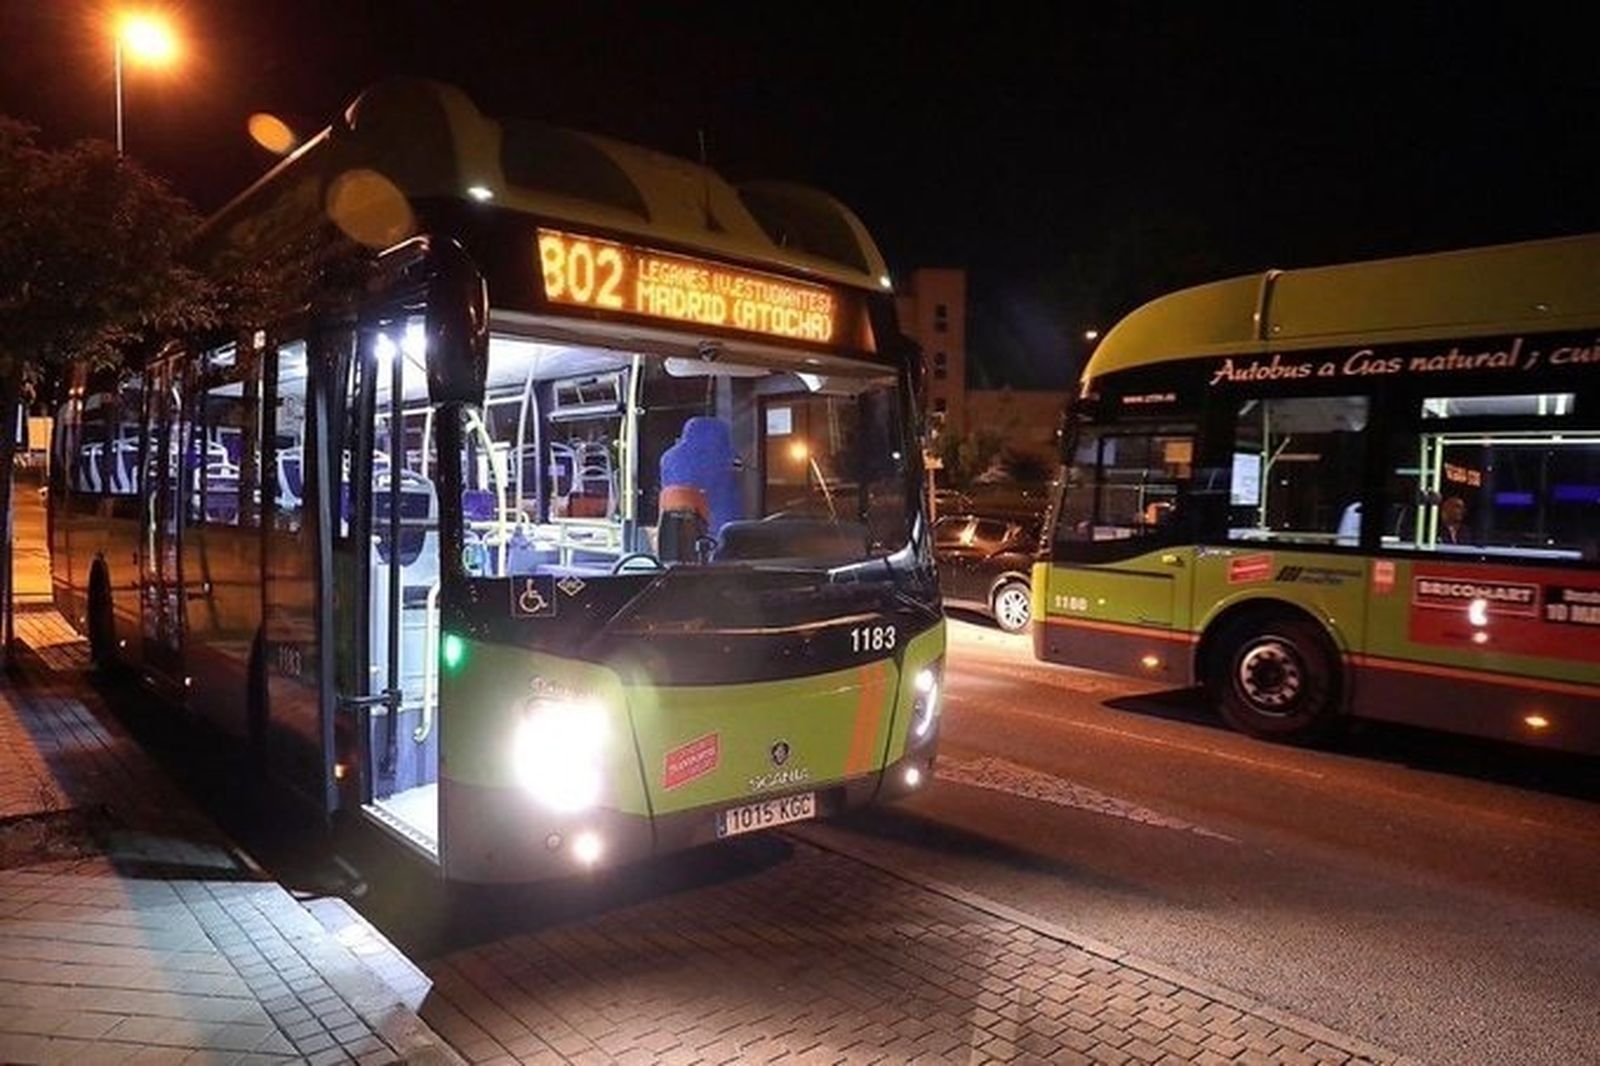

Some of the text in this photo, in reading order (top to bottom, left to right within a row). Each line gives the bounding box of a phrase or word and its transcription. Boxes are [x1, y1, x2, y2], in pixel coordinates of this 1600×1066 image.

[637, 257, 710, 292] LEGANES
[635, 280, 833, 343] MADRID (ATOCHA)
[1210, 354, 1312, 385] Autobus
[1318, 363, 1336, 376] a
[1342, 349, 1402, 376] Gas
[1408, 337, 1524, 372] natural
[1419, 581, 1532, 602] BRICOMART
[849, 625, 897, 653] 1183
[731, 794, 812, 832] 1015 KGC
